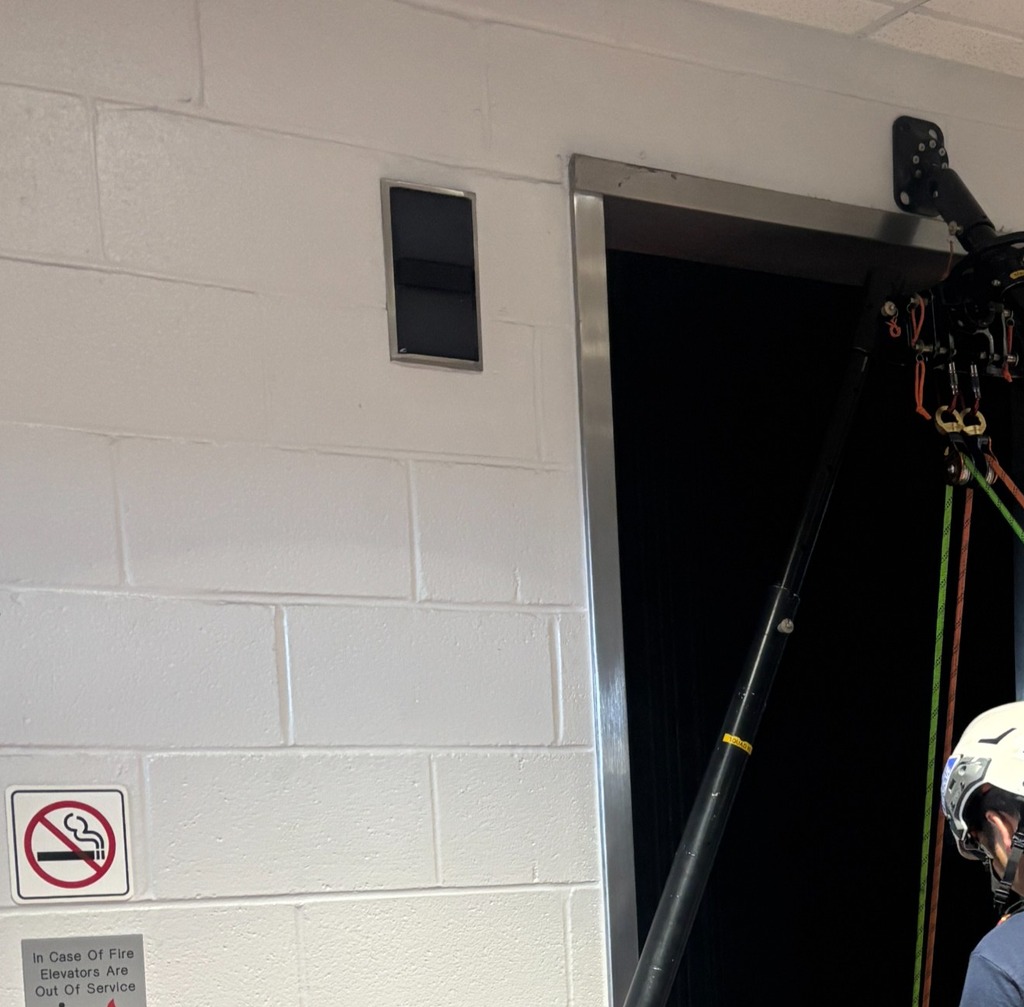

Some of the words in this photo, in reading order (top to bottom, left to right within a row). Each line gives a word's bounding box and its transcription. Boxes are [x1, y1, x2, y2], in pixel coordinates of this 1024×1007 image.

[32, 952, 44, 964] In
[49, 951, 82, 963] Case
[87, 949, 104, 961] Of
[109, 948, 135, 960] Fire
[40, 967, 100, 980] Elevators
[106, 965, 129, 977] Are
[35, 985, 59, 997] Out
[64, 983, 81, 996] Of
[87, 981, 136, 994] Service
